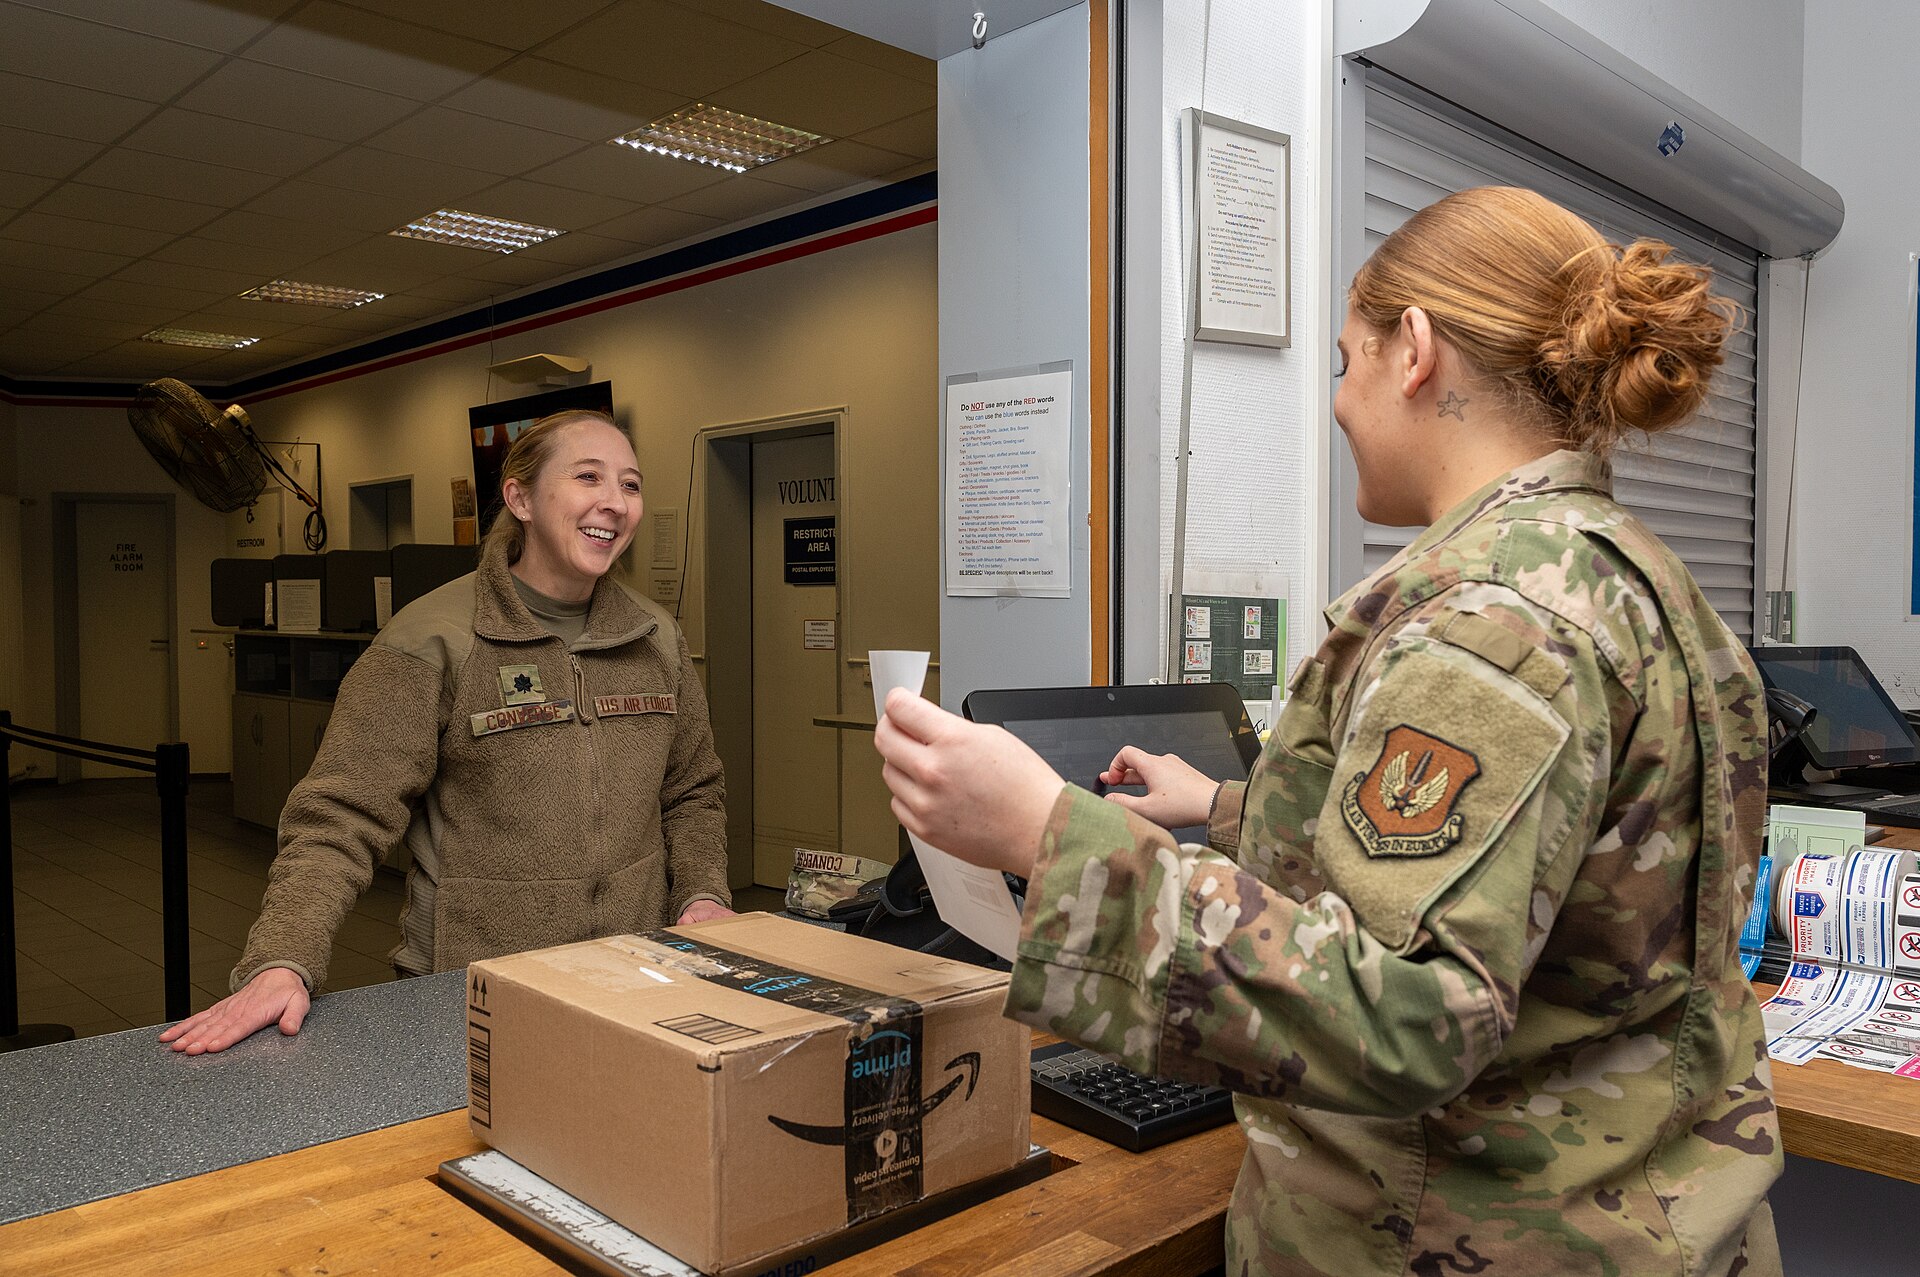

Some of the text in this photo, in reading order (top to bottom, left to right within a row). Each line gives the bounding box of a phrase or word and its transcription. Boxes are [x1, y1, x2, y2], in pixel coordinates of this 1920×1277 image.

[971, 402, 984, 411] NOT
[237, 538, 265, 548] RESTROOM
[808, 542, 830, 552] AREA
[110, 553, 143, 561] ALARM
[114, 563, 143, 572] ROOM
[624, 698, 640, 712] AIR
[643, 696, 673, 711] FORCE
[486, 704, 562, 730] CONVERSE
[1391, 840, 1401, 850] IN
[797, 852, 843, 871] CONVERSE
[1802, 860, 1812, 884] PRIORITY
[751, 977, 812, 994] prime
[1785, 980, 1799, 996] PRIORITY
[852, 1044, 911, 1078] prime
[852, 1105, 909, 1127] free delivery
[853, 1155, 920, 1185] video streaming
[862, 1182, 880, 1192] movies
[881, 1176, 891, 1186] and
[898, 1170, 913, 1179] shows
